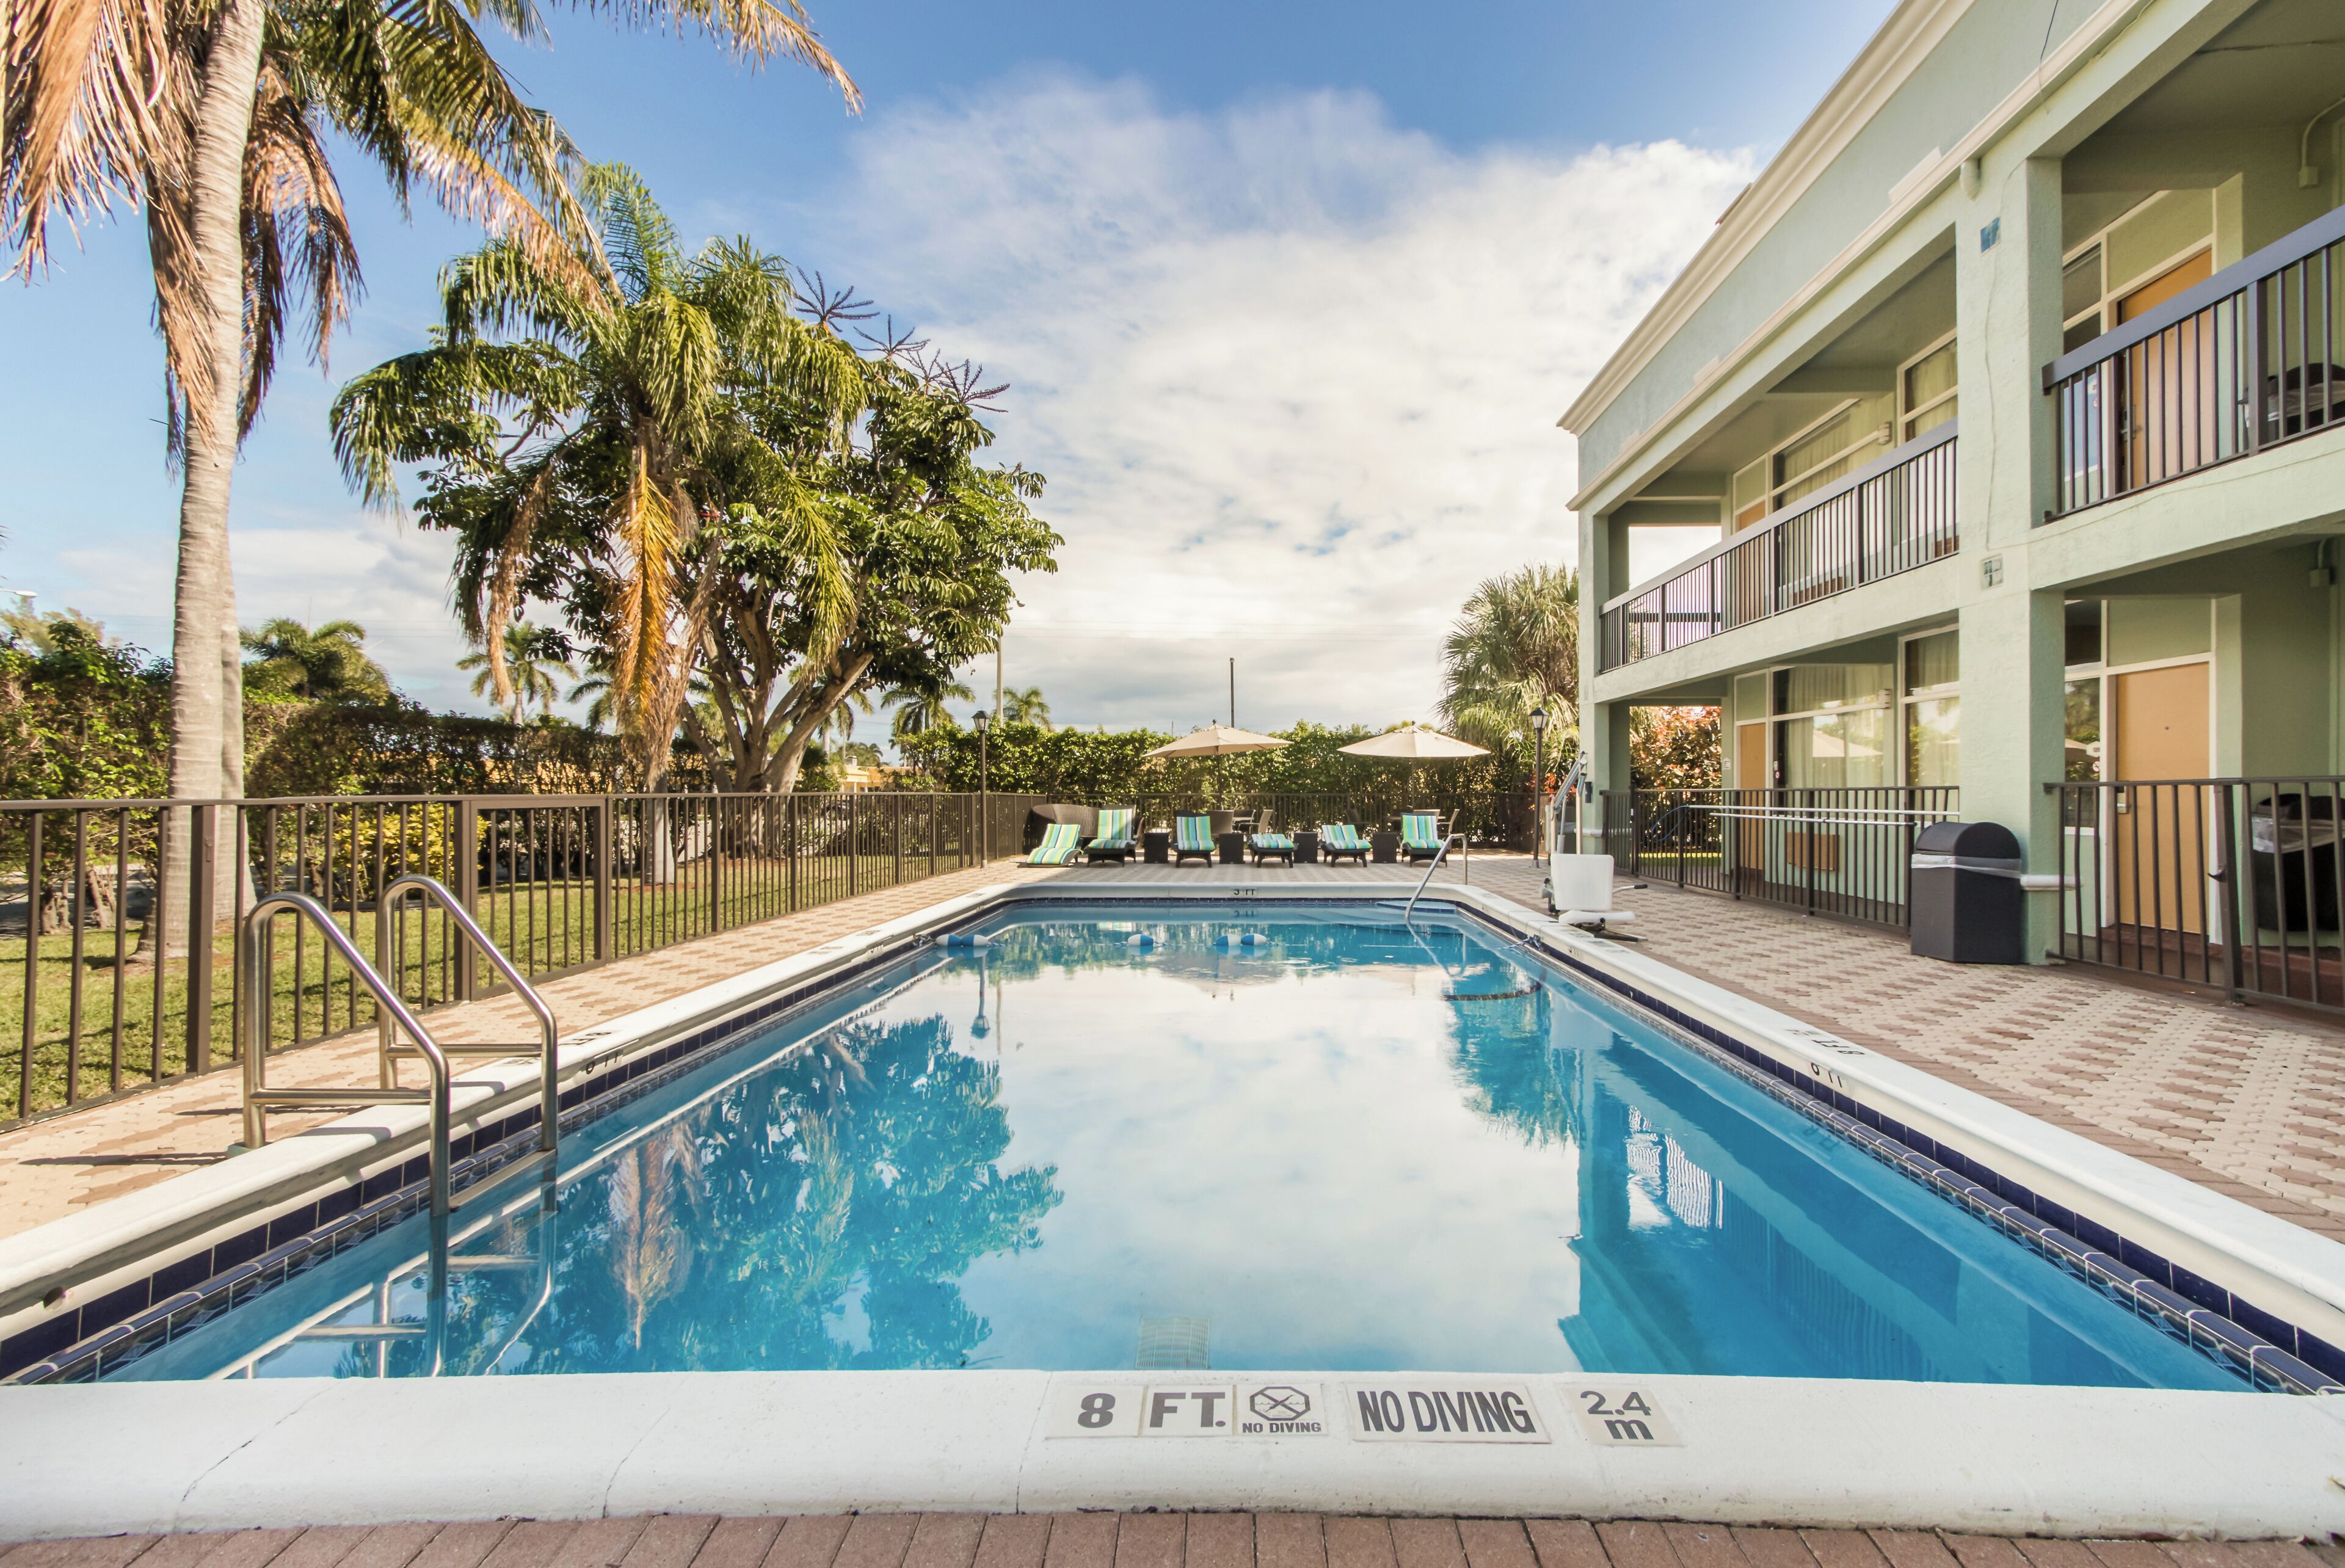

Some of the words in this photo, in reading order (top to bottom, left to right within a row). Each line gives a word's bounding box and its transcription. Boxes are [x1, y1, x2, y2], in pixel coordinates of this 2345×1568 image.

[1077, 1393, 1116, 1428] 8
[1149, 1392, 1226, 1428] FT.
[1356, 1390, 1405, 1433] NO
[1407, 1391, 1537, 1434] DIVING
[1580, 1390, 1652, 1416] 2.4
[1242, 1423, 1263, 1433] NO
[1269, 1422, 1322, 1433] DIVING
[1604, 1419, 1655, 1440] m
